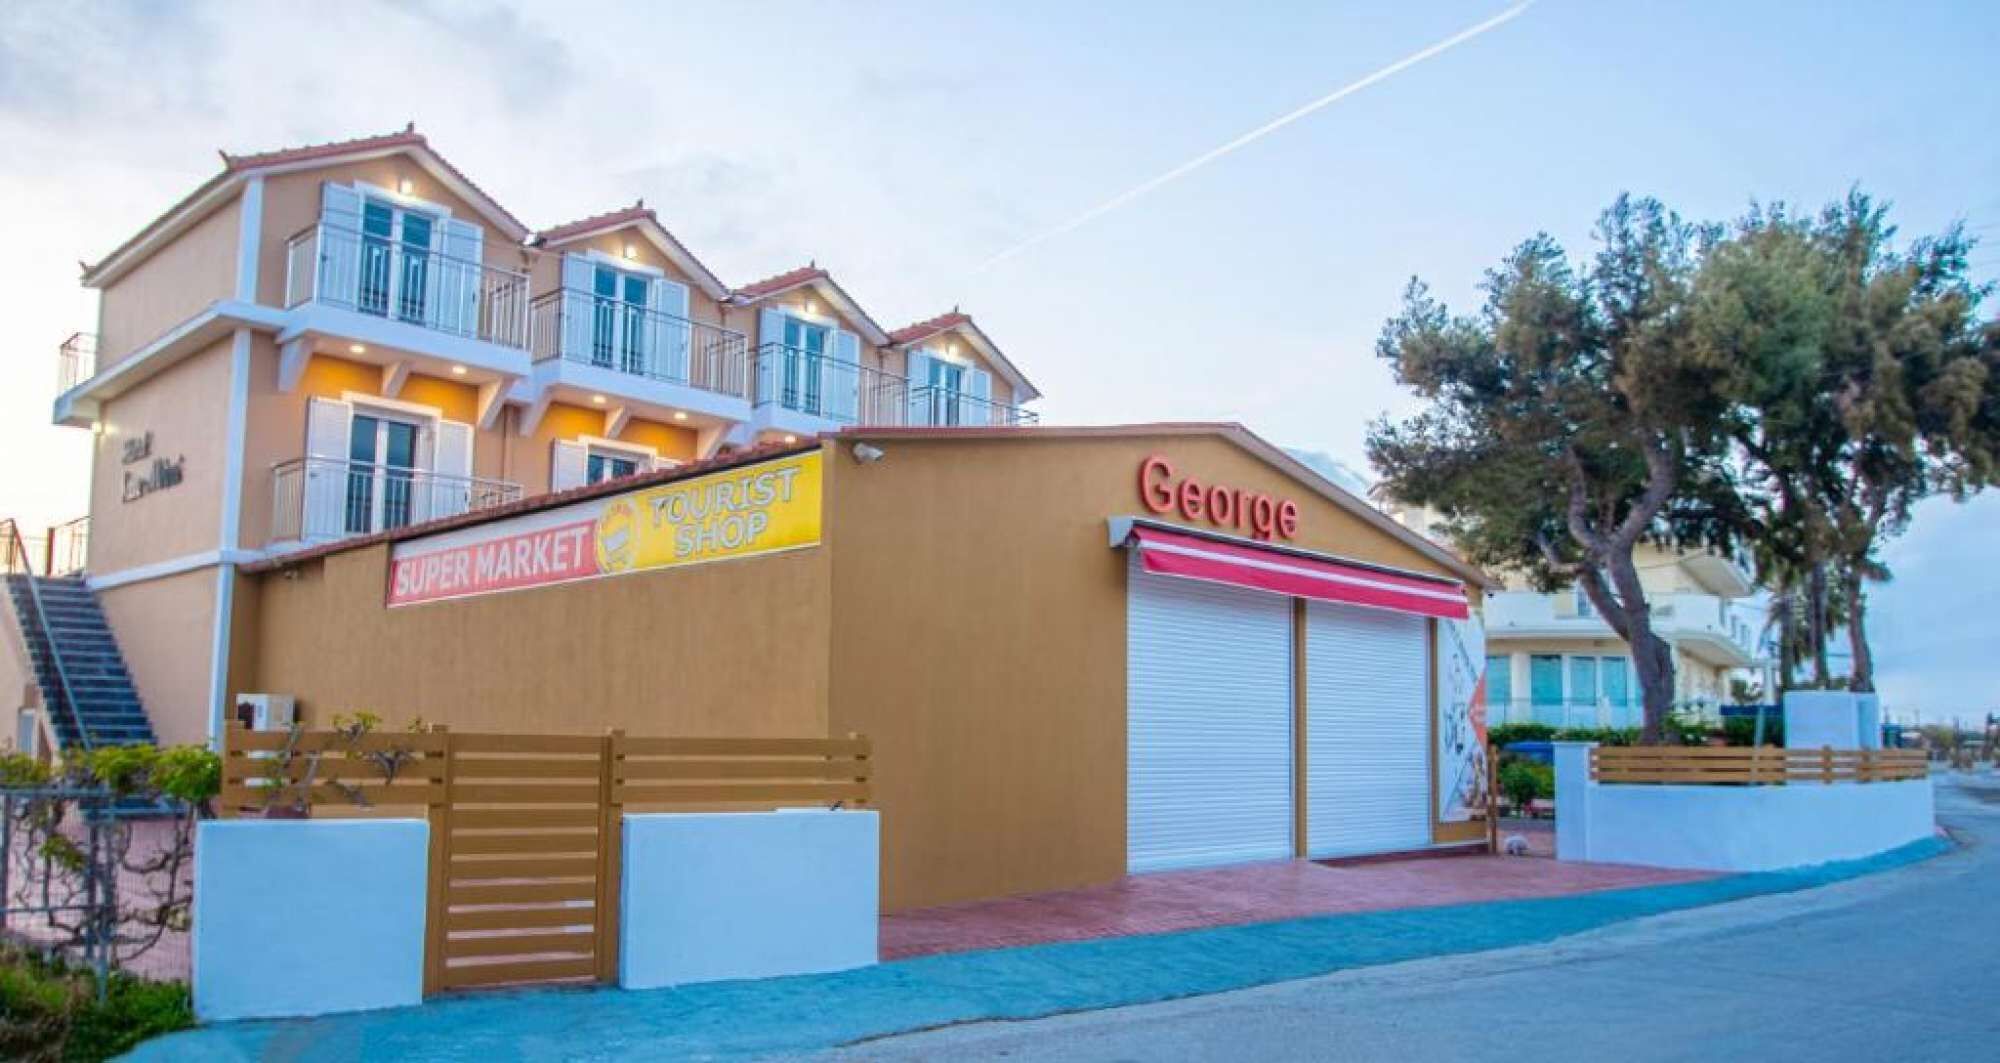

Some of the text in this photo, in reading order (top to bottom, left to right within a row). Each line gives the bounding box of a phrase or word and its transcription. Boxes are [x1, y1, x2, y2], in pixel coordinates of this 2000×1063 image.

[652, 467, 799, 525] TOURIST
[1139, 453, 1297, 541] George
[396, 529, 587, 597] SUPER MARKET
[676, 513, 767, 557] SHOP
